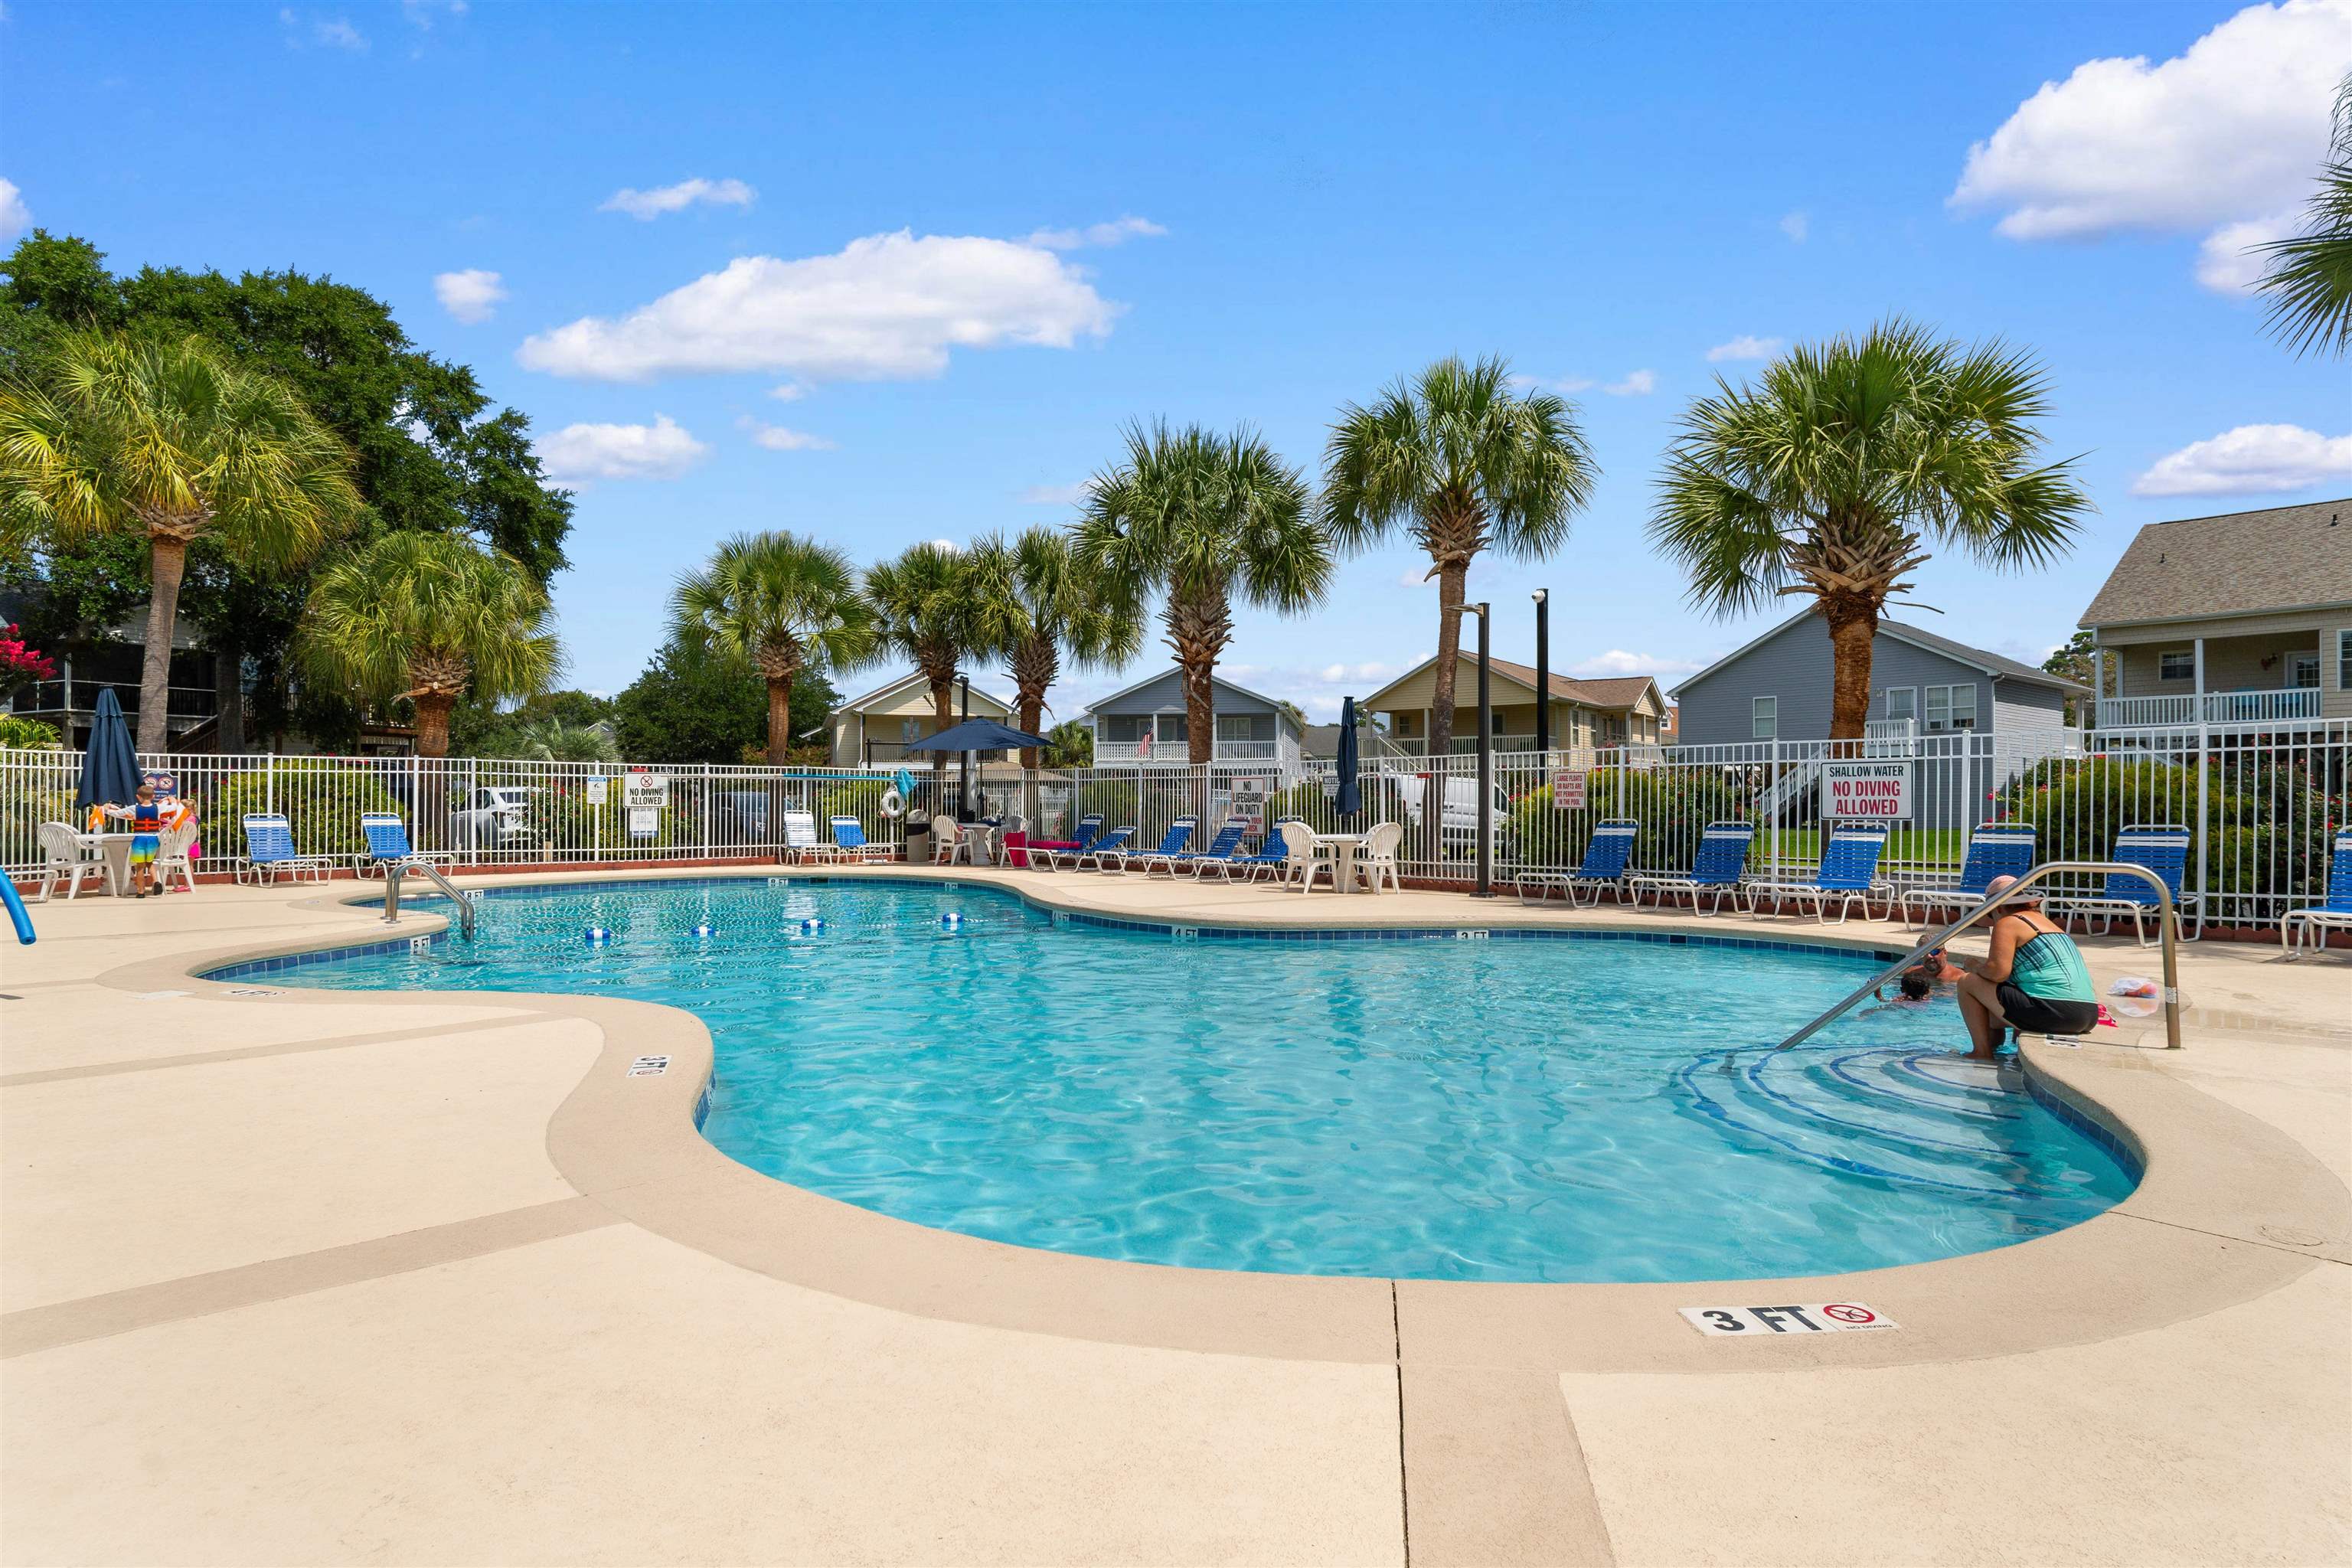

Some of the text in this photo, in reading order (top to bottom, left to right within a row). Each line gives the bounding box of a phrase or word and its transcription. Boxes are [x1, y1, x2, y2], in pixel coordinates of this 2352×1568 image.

[1829, 766, 1904, 777] SHALLOW WATER
[1243, 781, 1252, 791] NO
[1832, 780, 1900, 796] NO DIVING
[629, 788, 664, 796] NO DIVING
[1233, 792, 1263, 803] LIFEGUARD
[631, 797, 662, 805] ALLOWED
[1235, 804, 1260, 815] ON DUTY
[1835, 799, 1898, 815] ALLOWED
[1702, 1305, 1822, 1332] 3 FT
